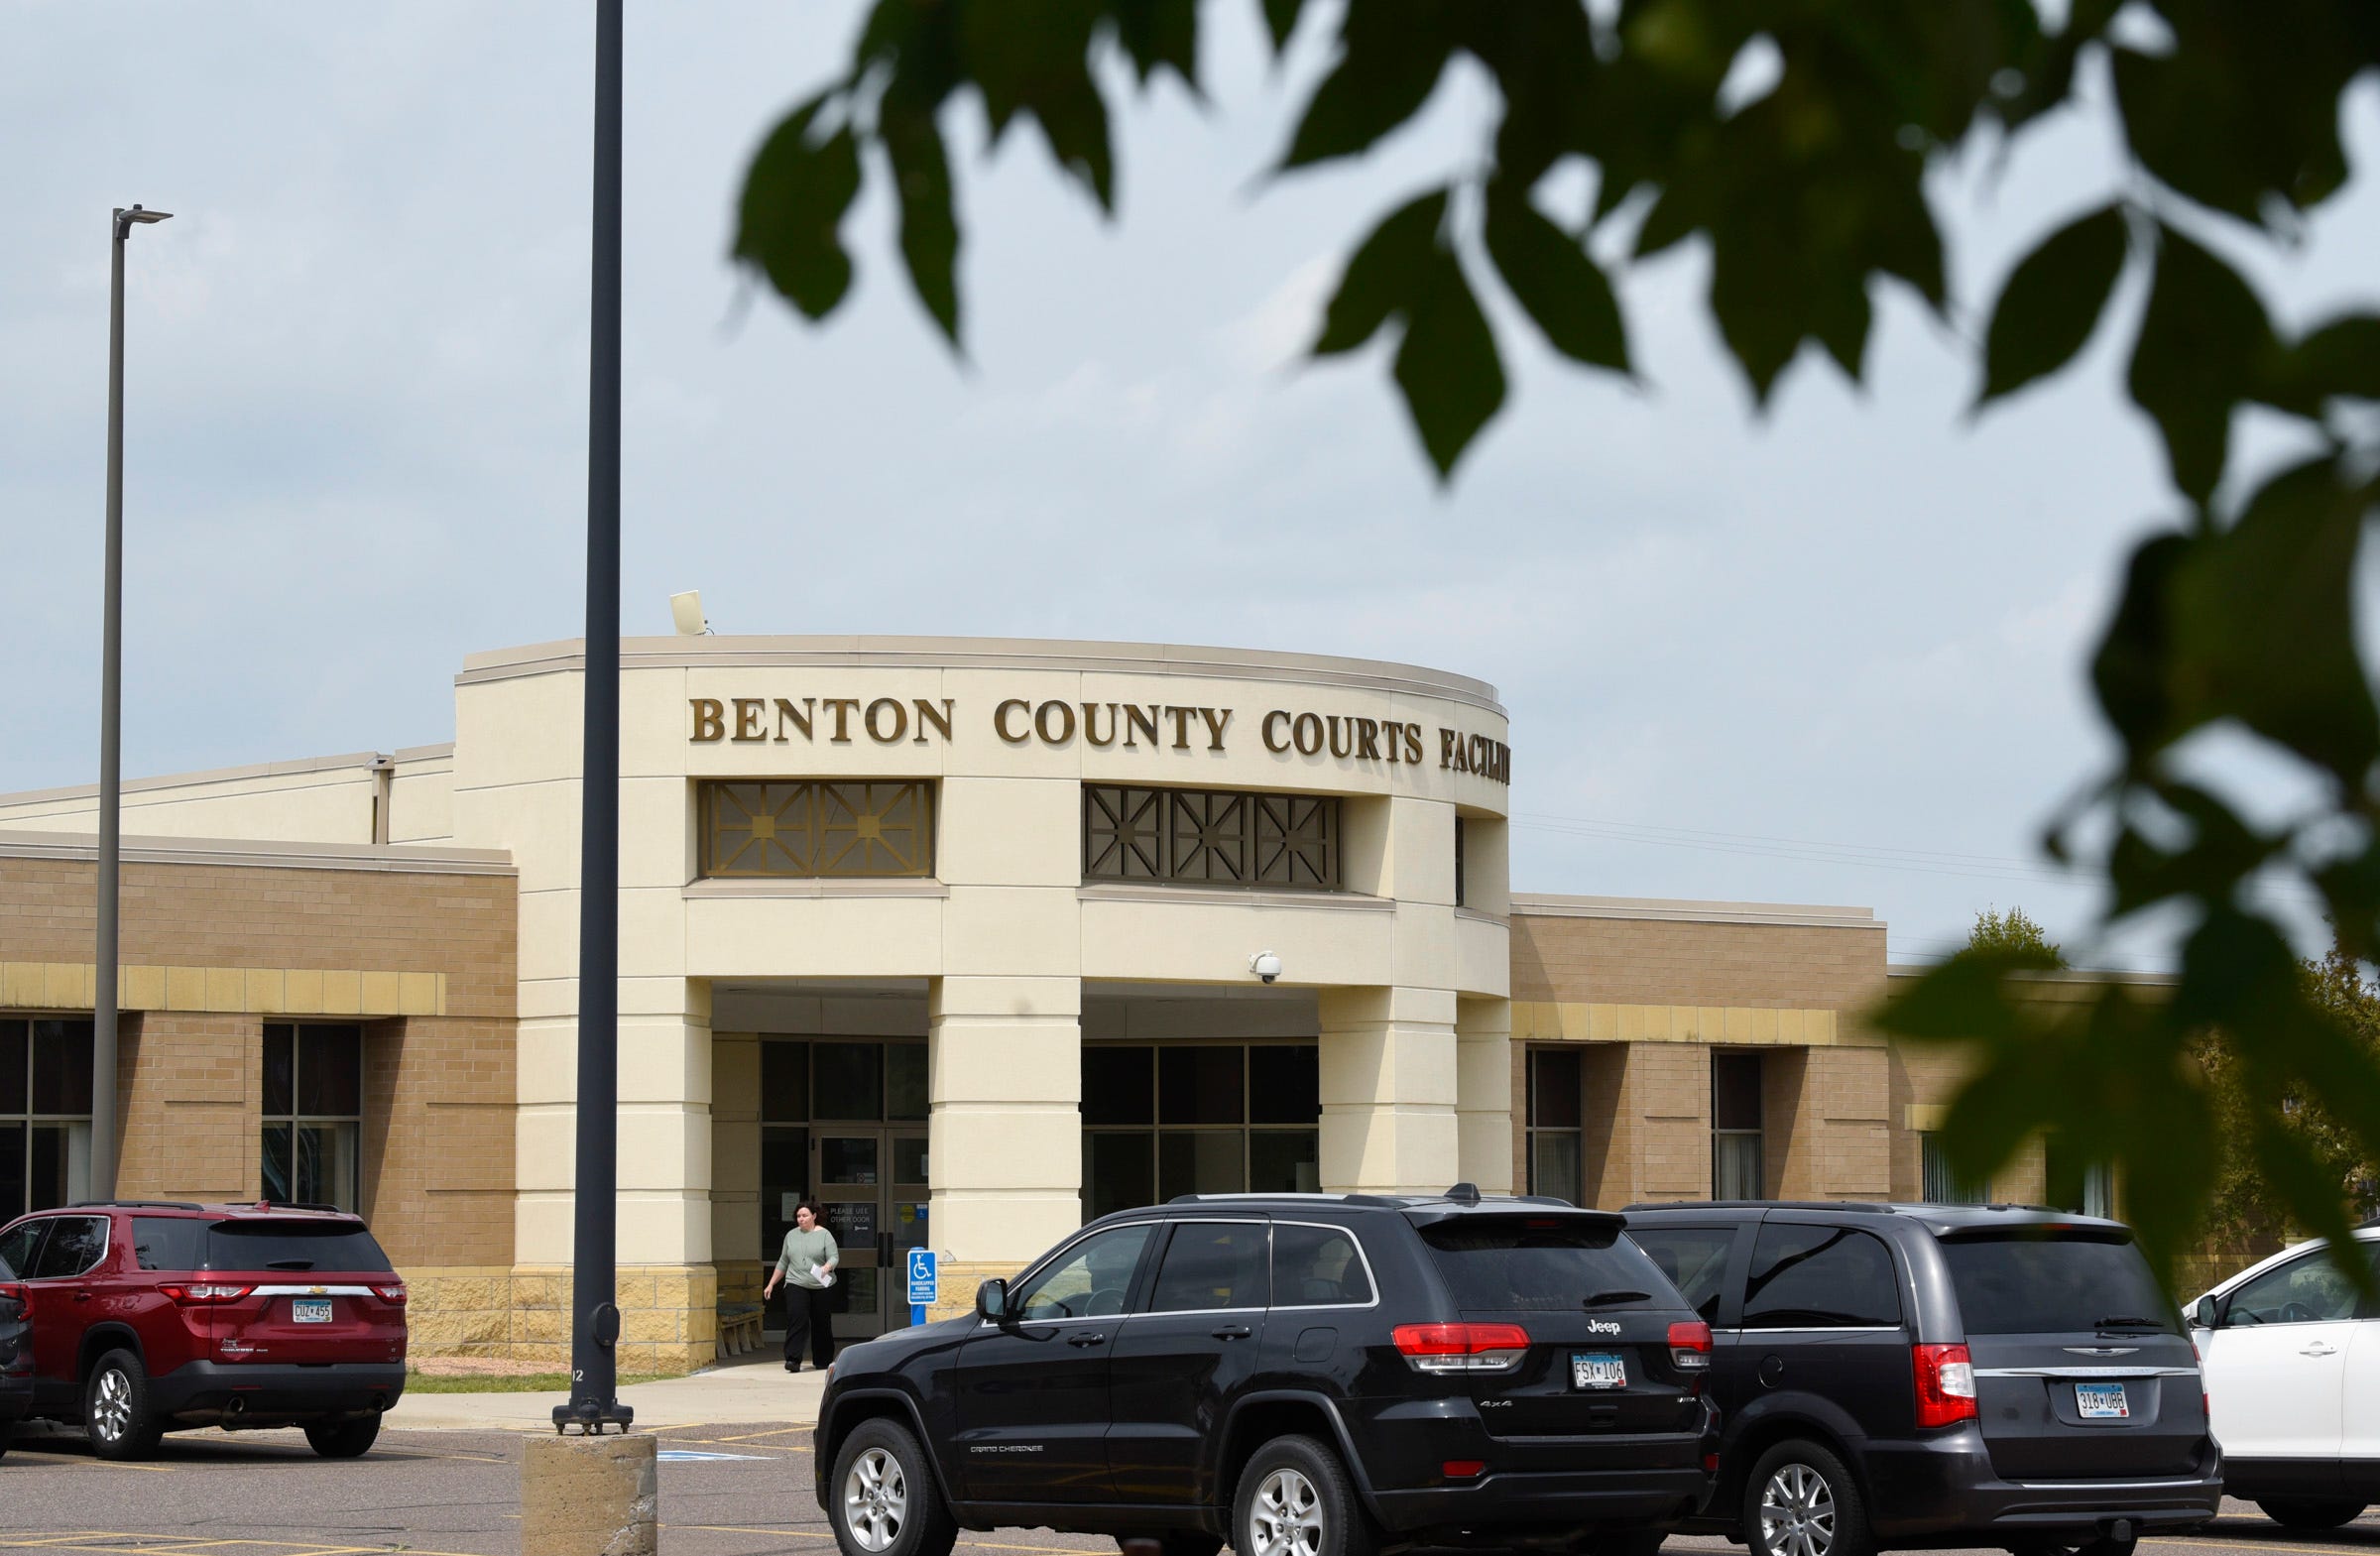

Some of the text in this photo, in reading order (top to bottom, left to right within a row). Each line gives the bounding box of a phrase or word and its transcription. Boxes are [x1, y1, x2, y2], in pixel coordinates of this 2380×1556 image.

[688, 697, 956, 744] BENTON
[994, 698, 1234, 751] COUNTY
[1261, 710, 1424, 765] COURTS
[295, 1305, 330, 1317] CUZ 455
[1587, 1318, 1621, 1336] Jeep
[1575, 1362, 1623, 1379] FSX 106
[2080, 1392, 2125, 1409] 318 UBB
